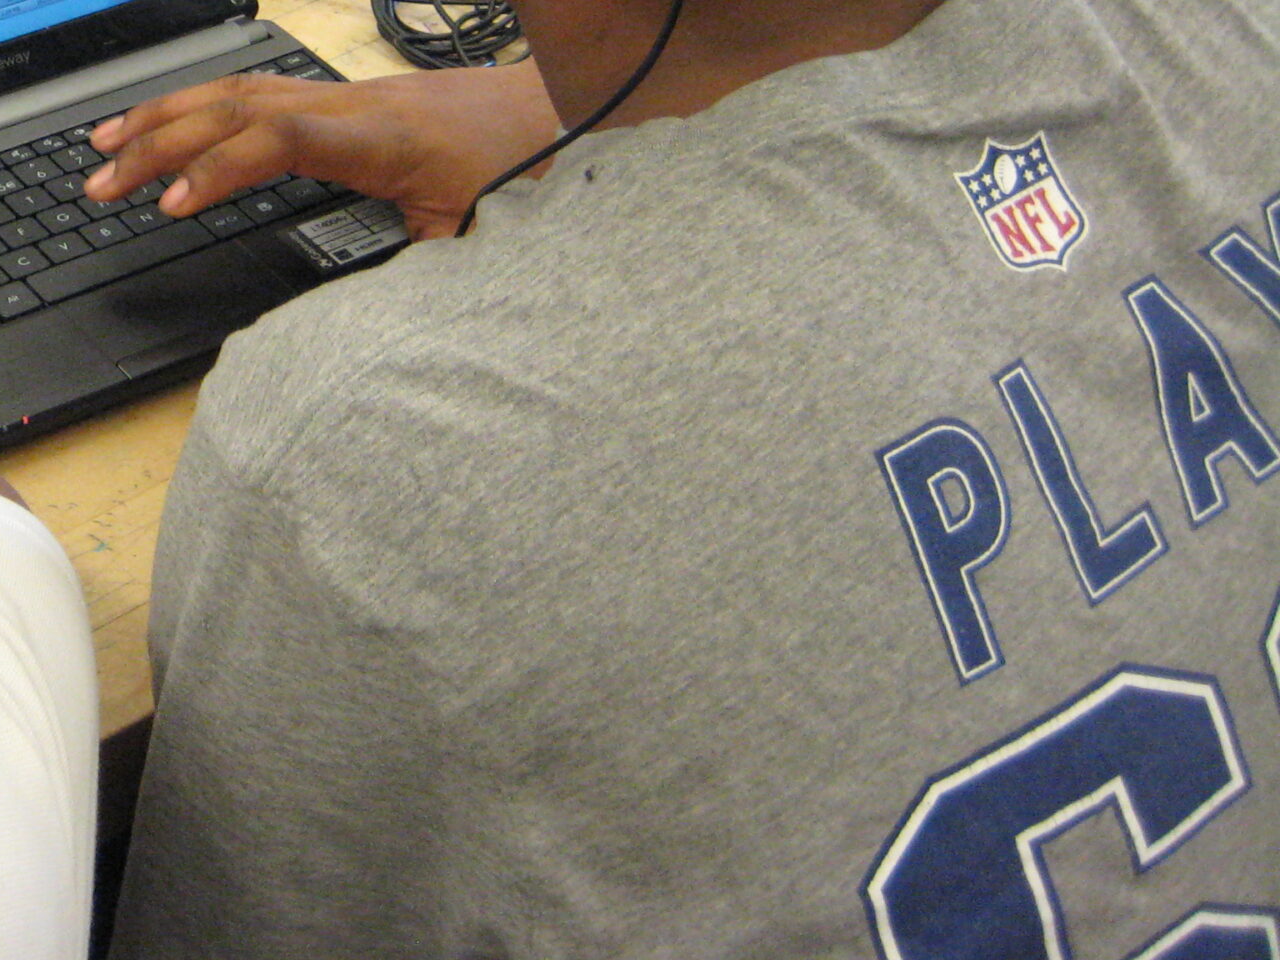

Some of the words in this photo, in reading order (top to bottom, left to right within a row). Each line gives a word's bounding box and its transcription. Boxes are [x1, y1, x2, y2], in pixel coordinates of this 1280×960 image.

[140, 213, 153, 222] N
[990, 187, 1079, 259] NFL
[101, 227, 111, 237] B
[18, 257, 30, 266] C
